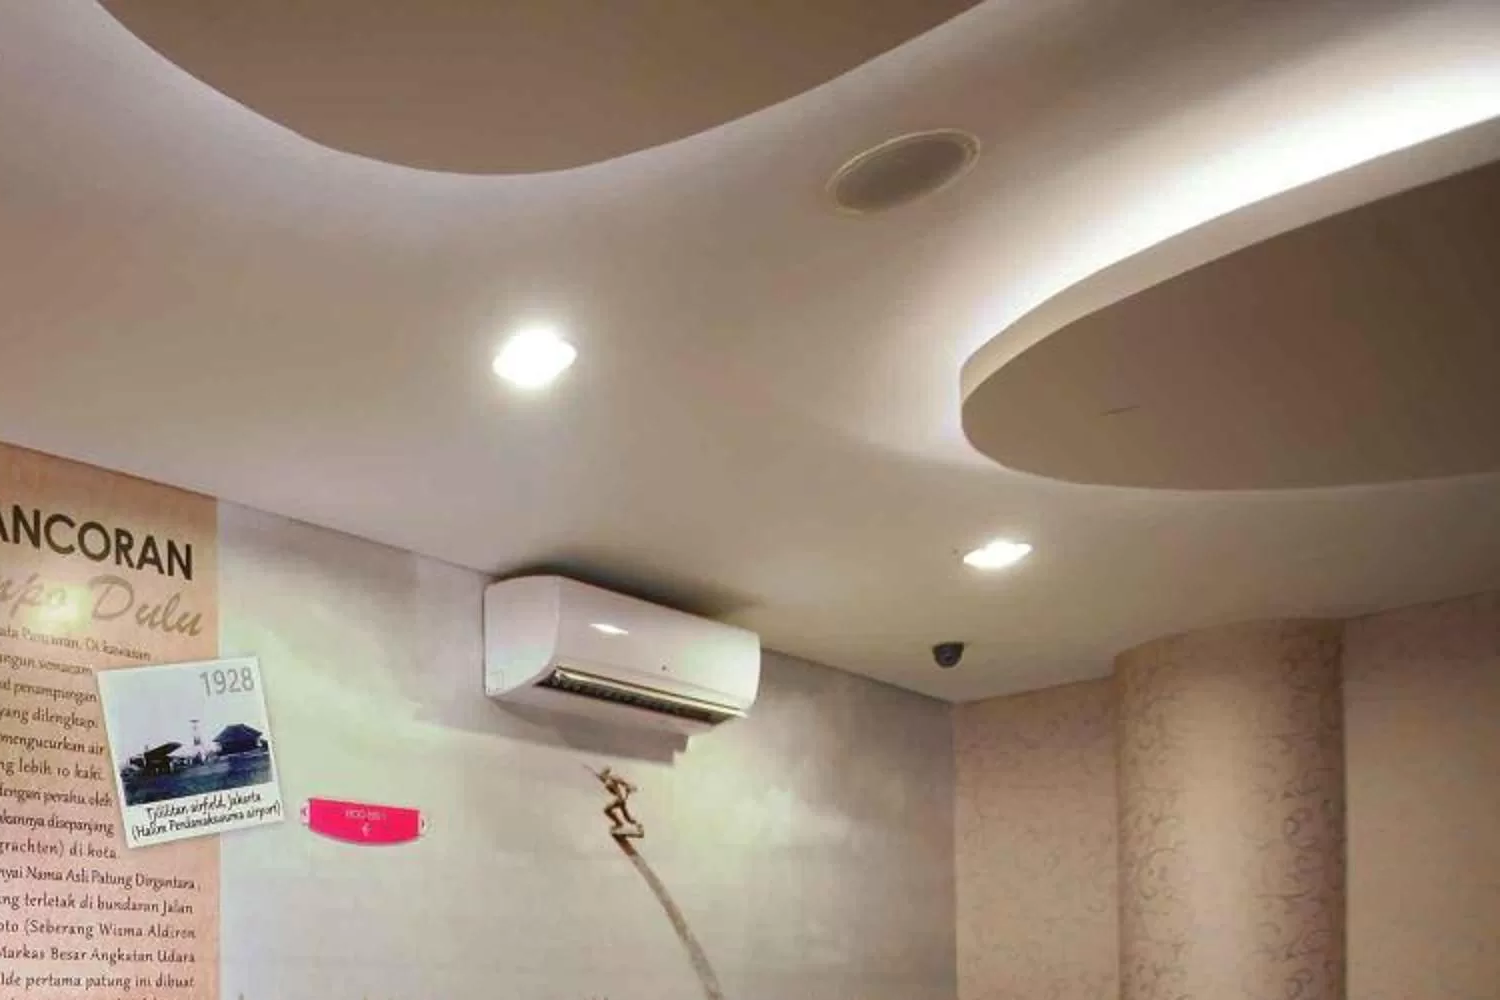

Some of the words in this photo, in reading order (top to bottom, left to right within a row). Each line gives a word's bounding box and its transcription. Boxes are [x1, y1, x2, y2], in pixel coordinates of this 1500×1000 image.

[87, 575, 202, 637] Dulu
[200, 666, 255, 697] 1928
[19, 757, 51, 775] lebih
[69, 840, 83, 857] di
[27, 866, 62, 881] Nama
[92, 870, 132, 889] Patung
[79, 893, 93, 909] di
[100, 921, 143, 937] Wisma
[51, 947, 87, 961] Besar
[90, 948, 153, 966] Angkatan
[157, 948, 195, 963] Udara
[25, 973, 82, 990] pertama
[85, 974, 131, 992] patung
[155, 972, 195, 988] dibuat
